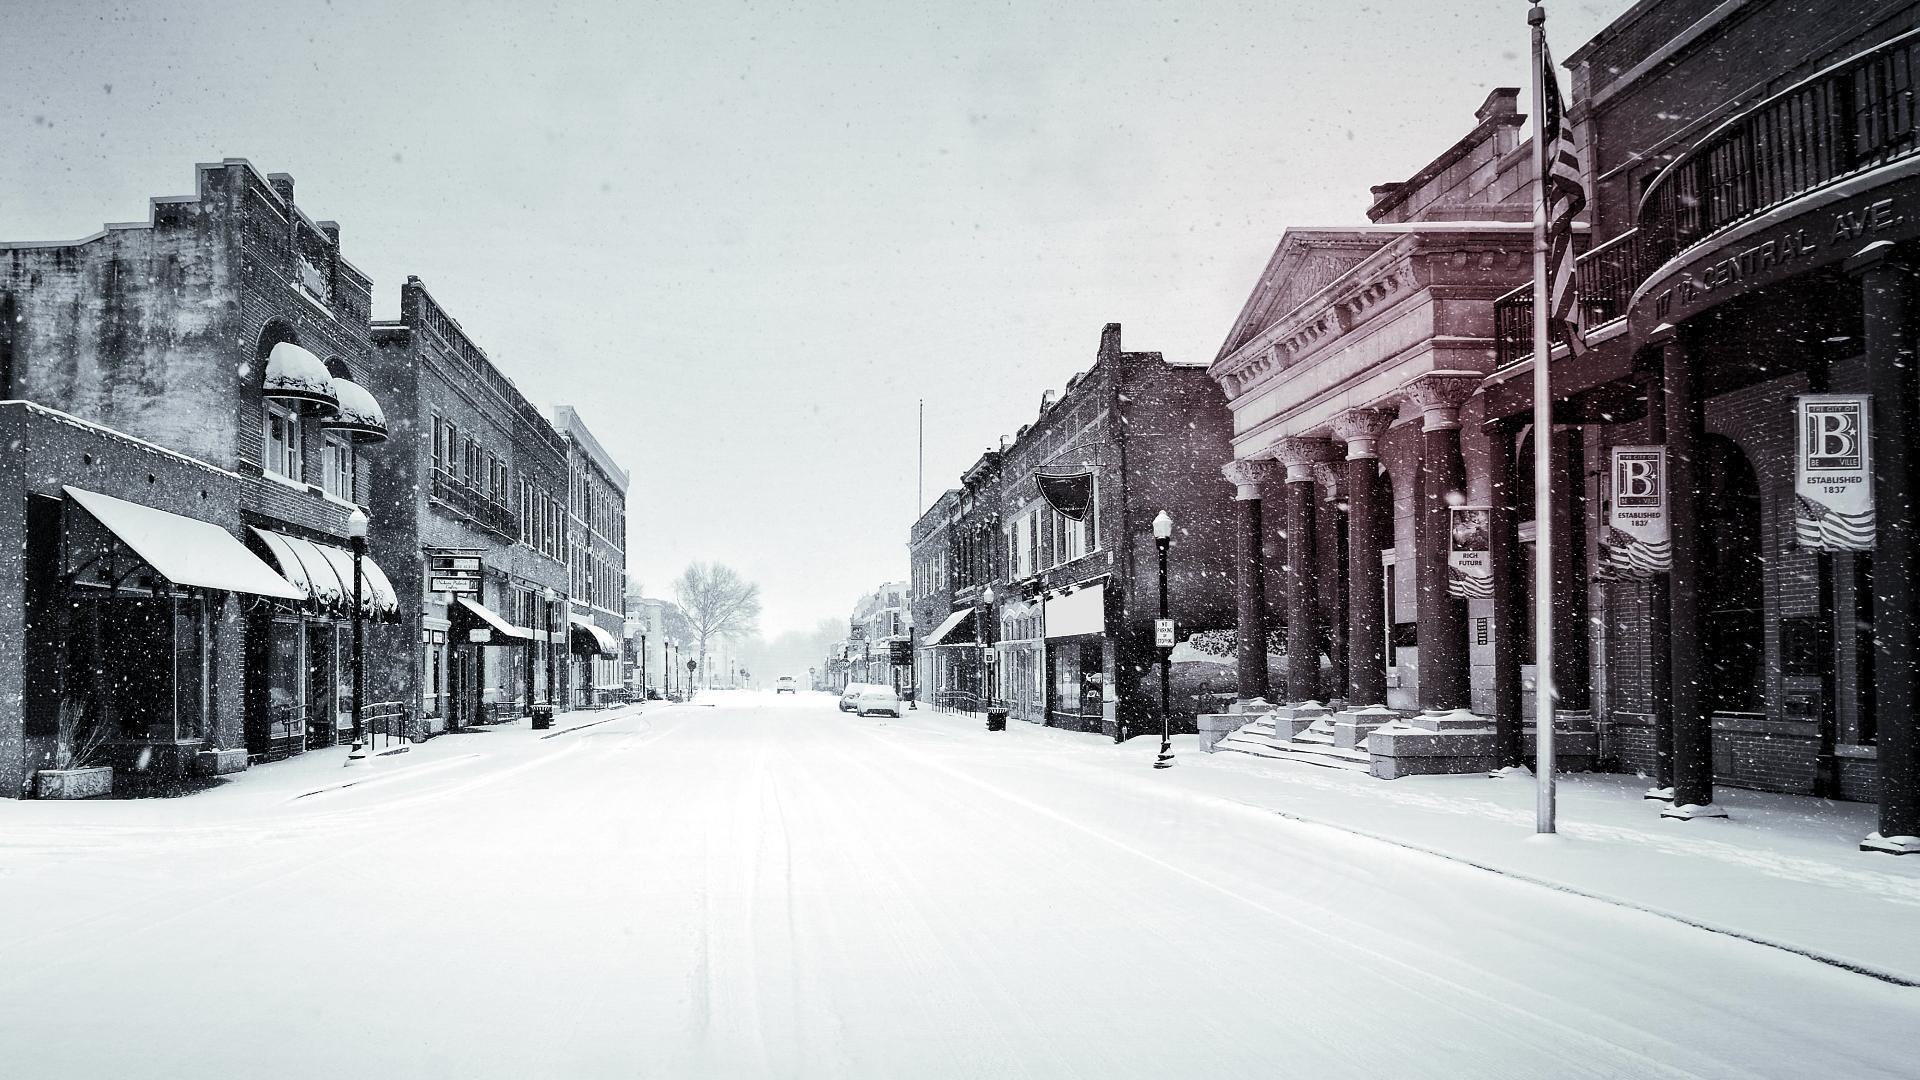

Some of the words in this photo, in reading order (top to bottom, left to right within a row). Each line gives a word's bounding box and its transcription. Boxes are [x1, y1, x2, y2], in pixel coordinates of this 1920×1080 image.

[1703, 228, 1816, 291] CENTRAL
[1828, 198, 1904, 245] AVE.
[1809, 413, 1854, 458] B
[1619, 460, 1655, 496] B
[1807, 476, 1862, 484] ESTABLISHED
[1823, 486, 1846, 494] 1837
